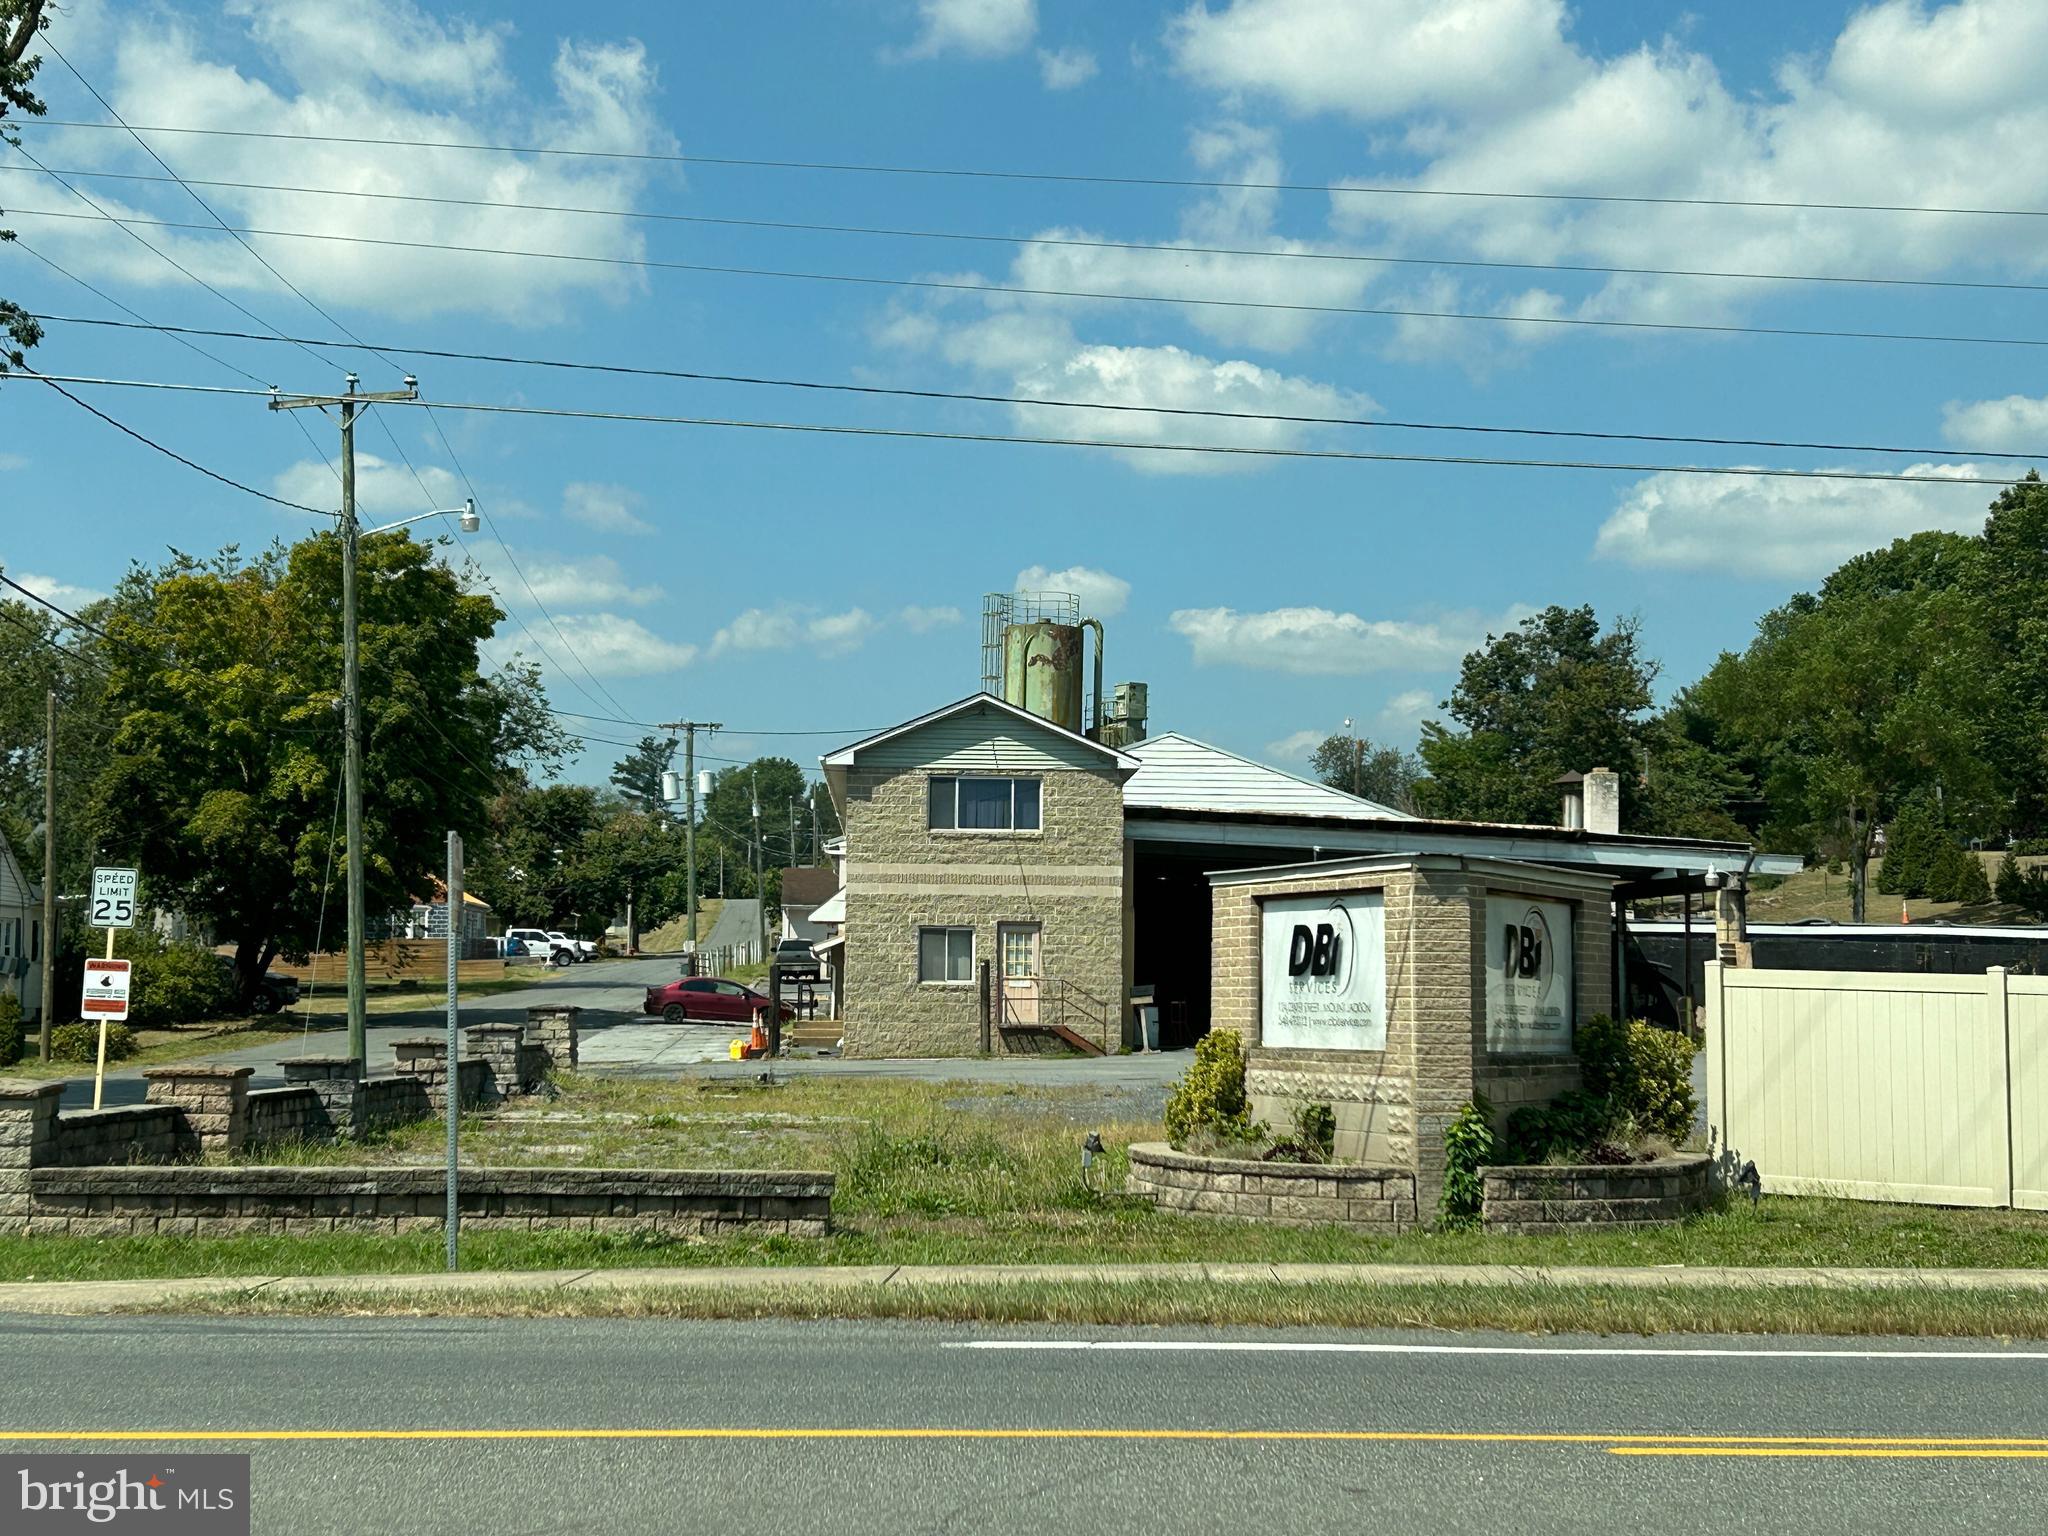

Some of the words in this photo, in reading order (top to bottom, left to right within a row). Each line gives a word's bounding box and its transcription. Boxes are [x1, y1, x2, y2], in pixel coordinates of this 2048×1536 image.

[96, 874, 134, 884] SPEED
[99, 887, 130, 896] LIMIT
[94, 899, 132, 921] 25
